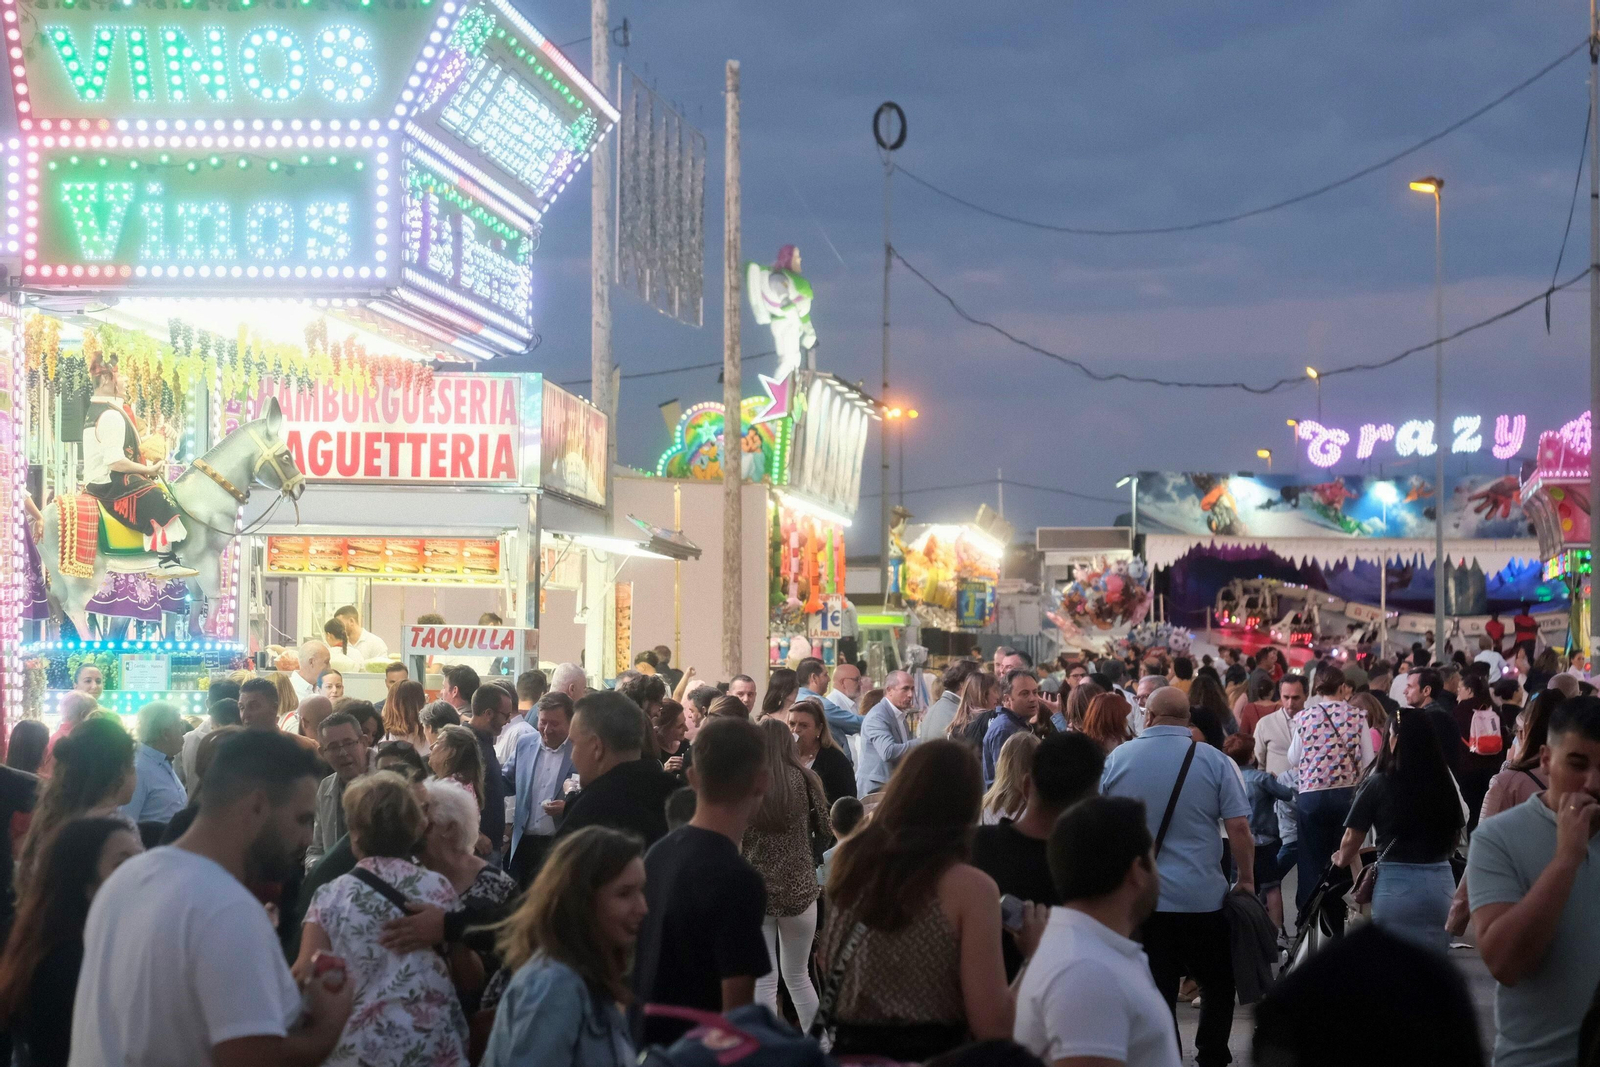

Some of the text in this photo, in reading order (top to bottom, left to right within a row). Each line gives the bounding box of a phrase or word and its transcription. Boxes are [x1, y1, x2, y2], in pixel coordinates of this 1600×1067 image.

[45, 25, 378, 103] VINOS
[61, 182, 351, 260] Vinos
[285, 430, 517, 479] AGUETTERIA
[1298, 413, 1527, 468] Crazy
[411, 627, 514, 651] TAQUILLA
